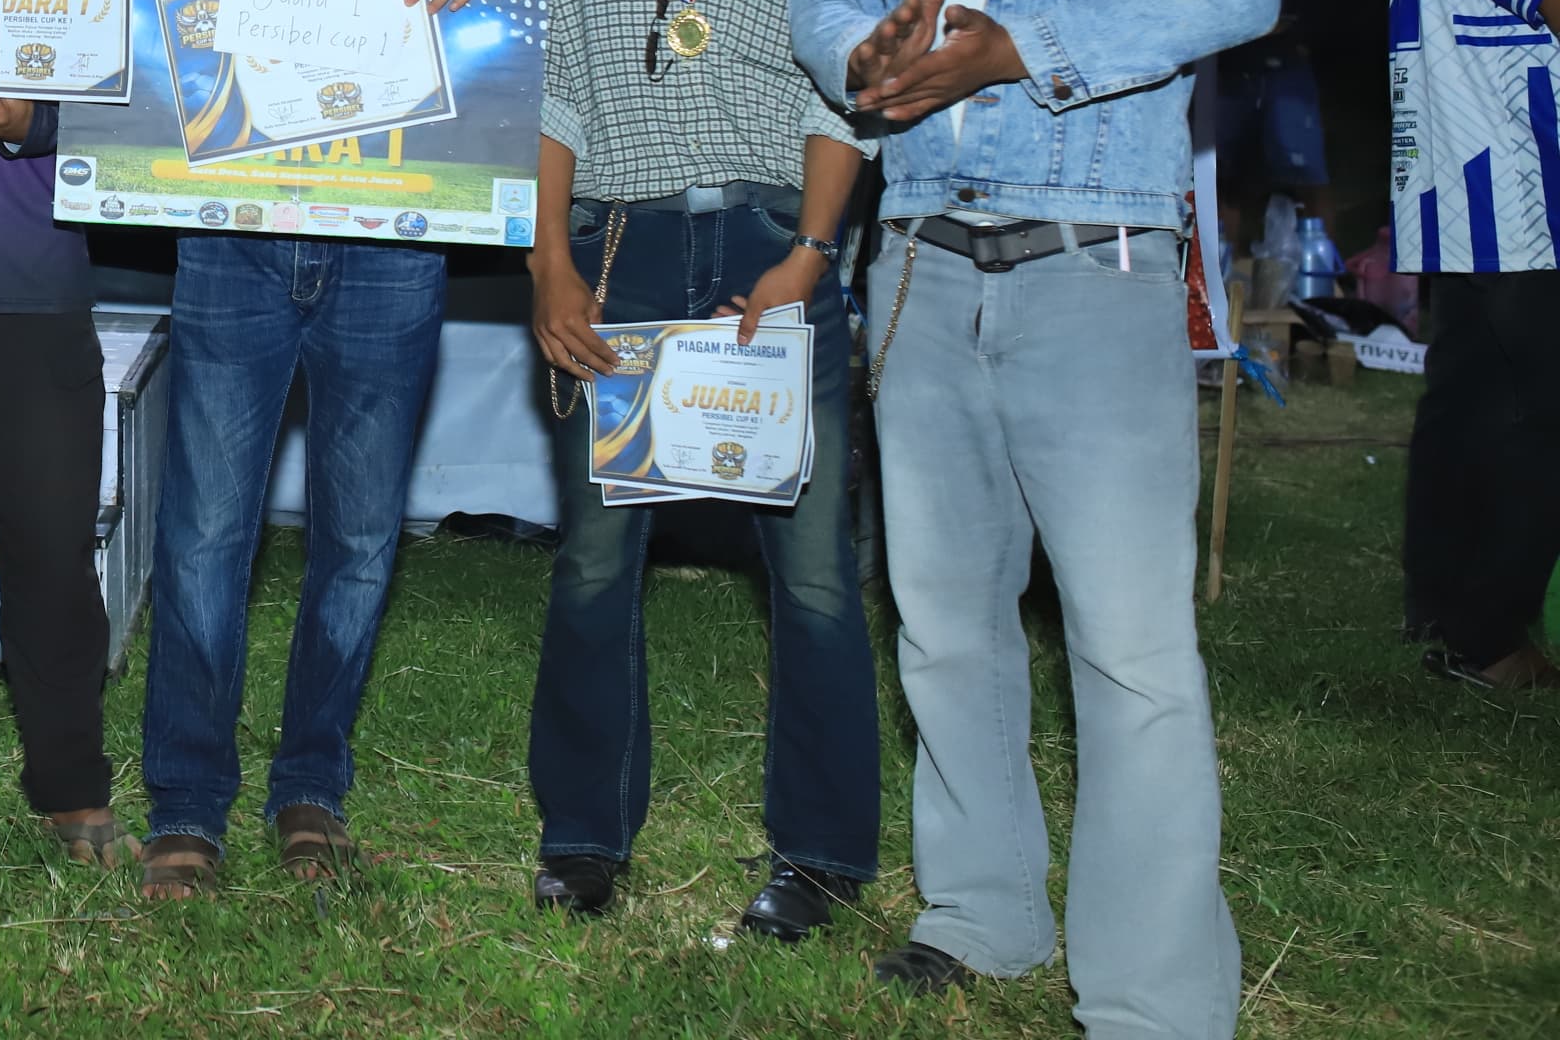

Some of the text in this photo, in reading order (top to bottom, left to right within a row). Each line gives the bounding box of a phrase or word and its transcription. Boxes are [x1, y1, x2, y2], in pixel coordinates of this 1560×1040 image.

[3, 15, 38, 24] PERSIBEL
[40, 16, 56, 24] CUP
[183, 30, 217, 45] PERSI
[238, 11, 322, 46] Persibel
[330, 31, 368, 55] cup
[677, 339, 787, 359] PIAGAM PENGHARGAAN
[681, 383, 779, 416] JUARA 1
